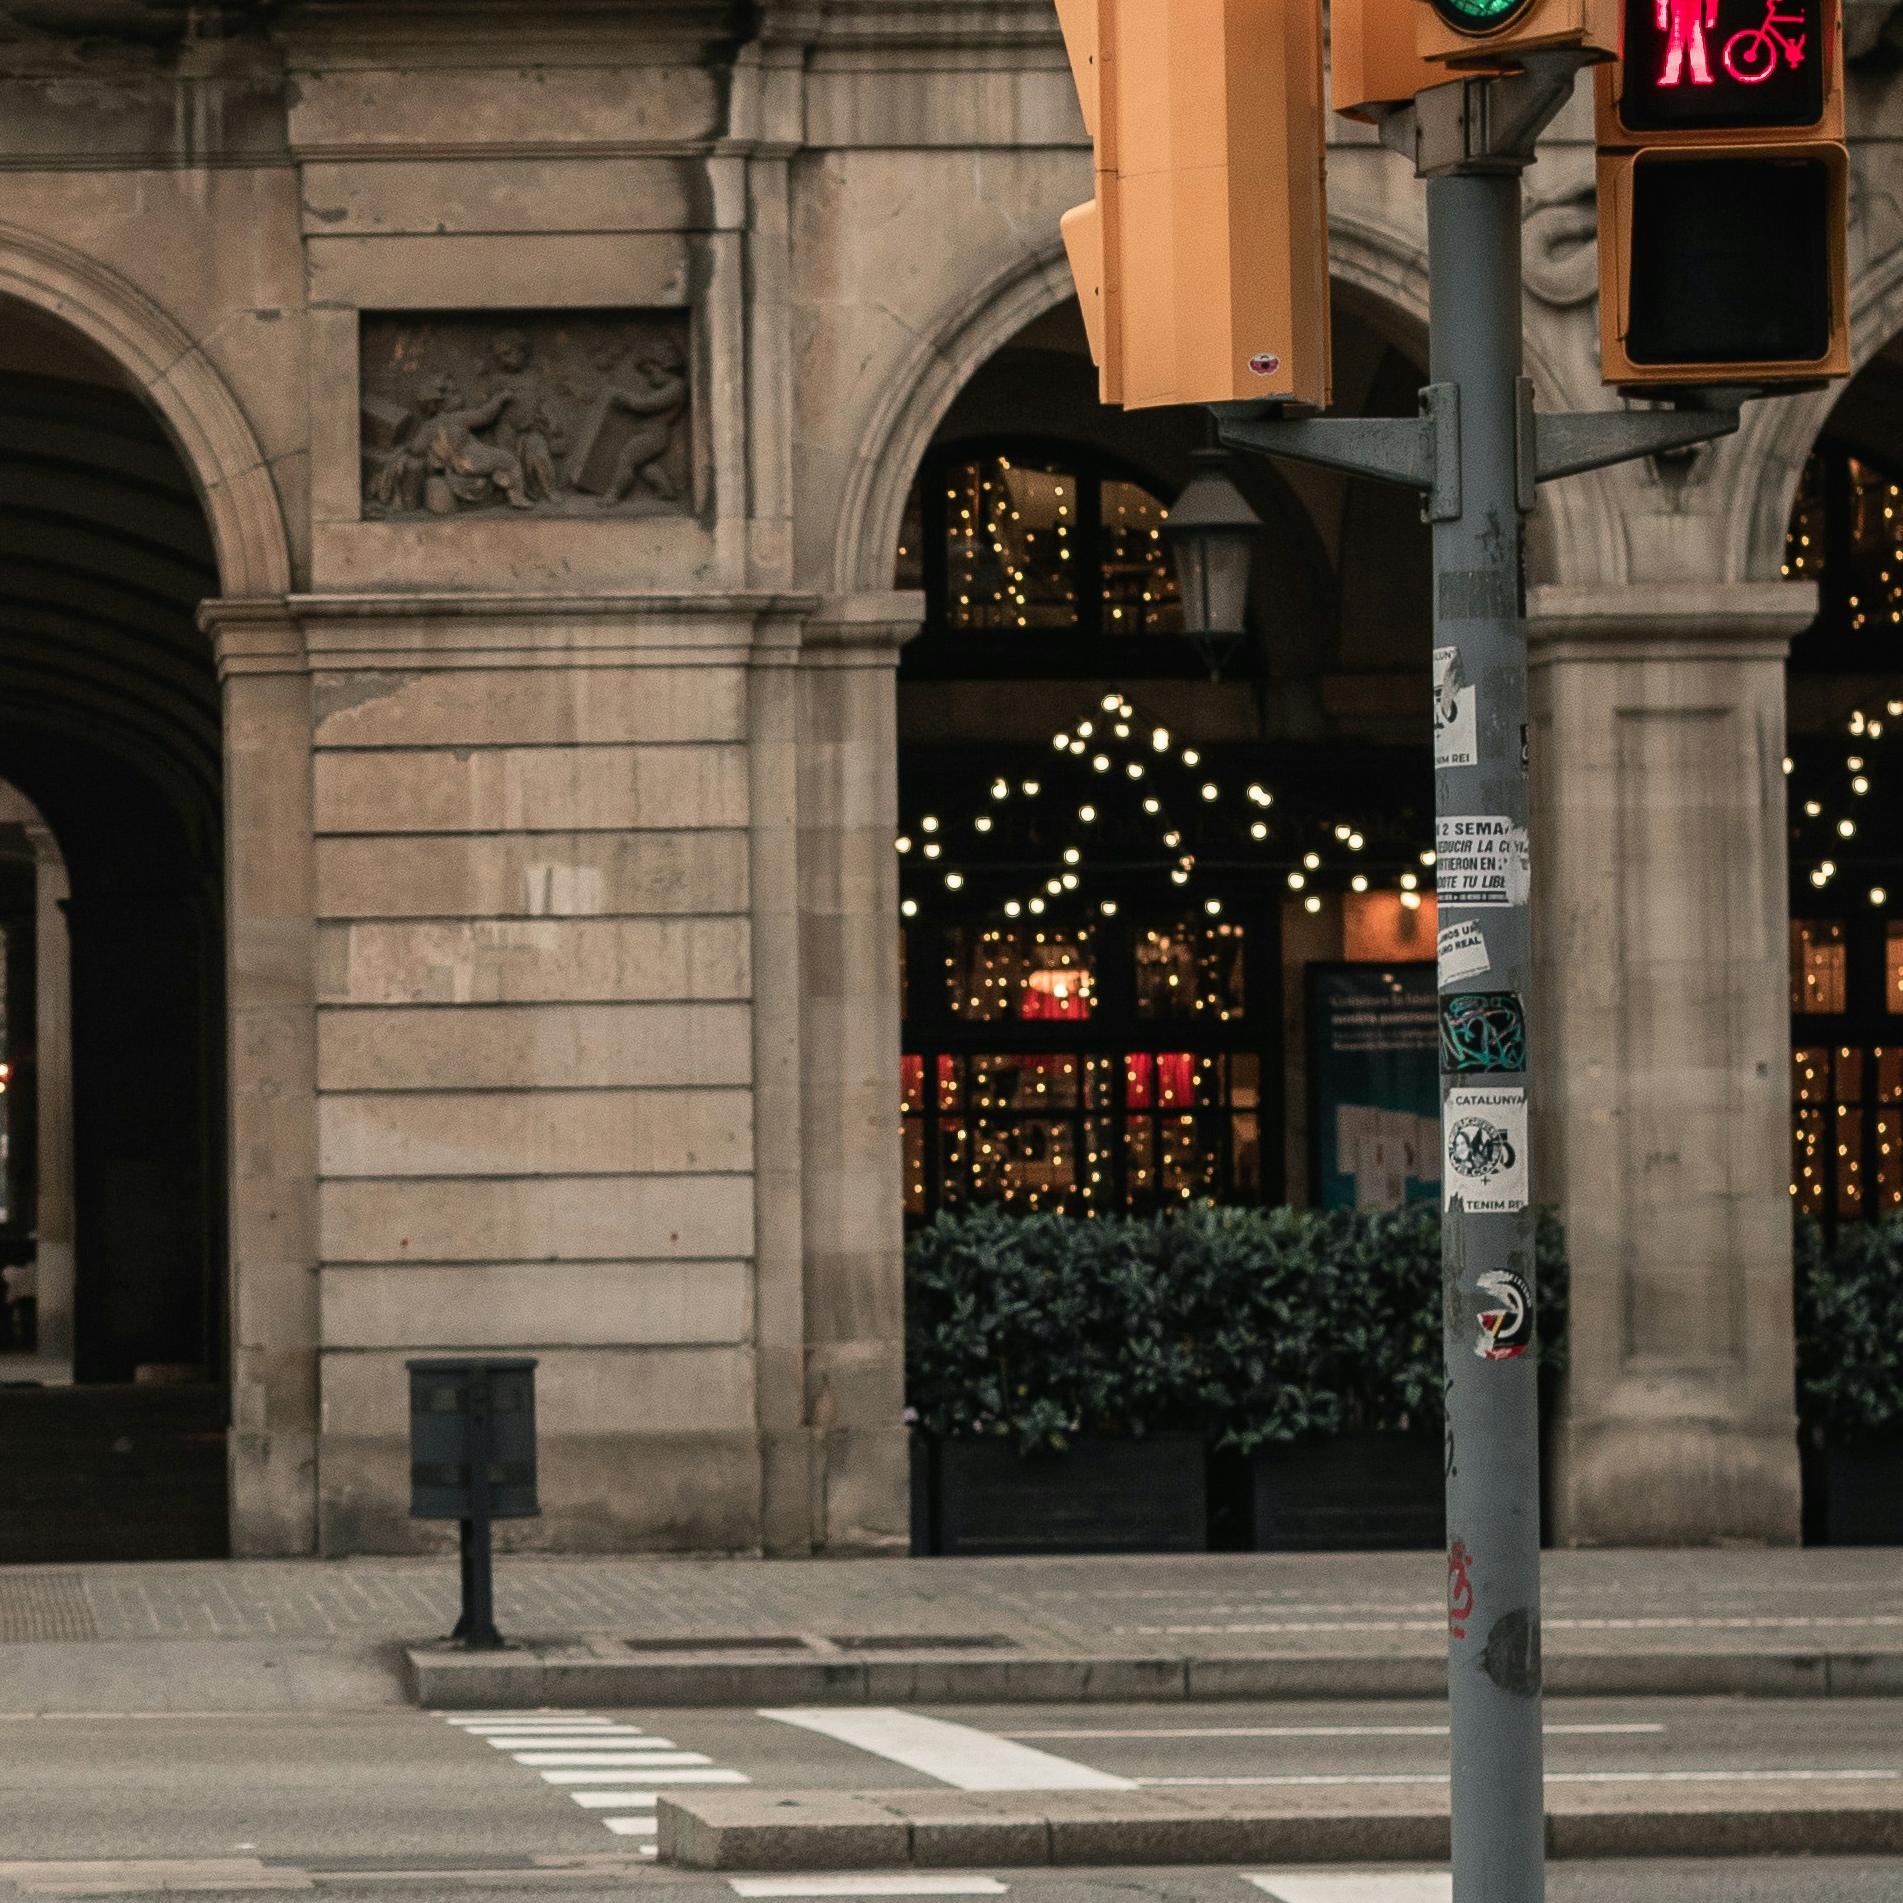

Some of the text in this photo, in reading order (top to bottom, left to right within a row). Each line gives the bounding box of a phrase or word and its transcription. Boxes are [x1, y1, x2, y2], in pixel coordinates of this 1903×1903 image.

[1442, 823, 1450, 836] 2
[1454, 822, 1509, 836] SEMA
[1477, 839, 1494, 853] LA
[1480, 856, 1496, 871] EN
[1462, 875, 1478, 889] TU
[1455, 935, 1482, 950] REAL
[1466, 1200, 1506, 1211] TENIM
